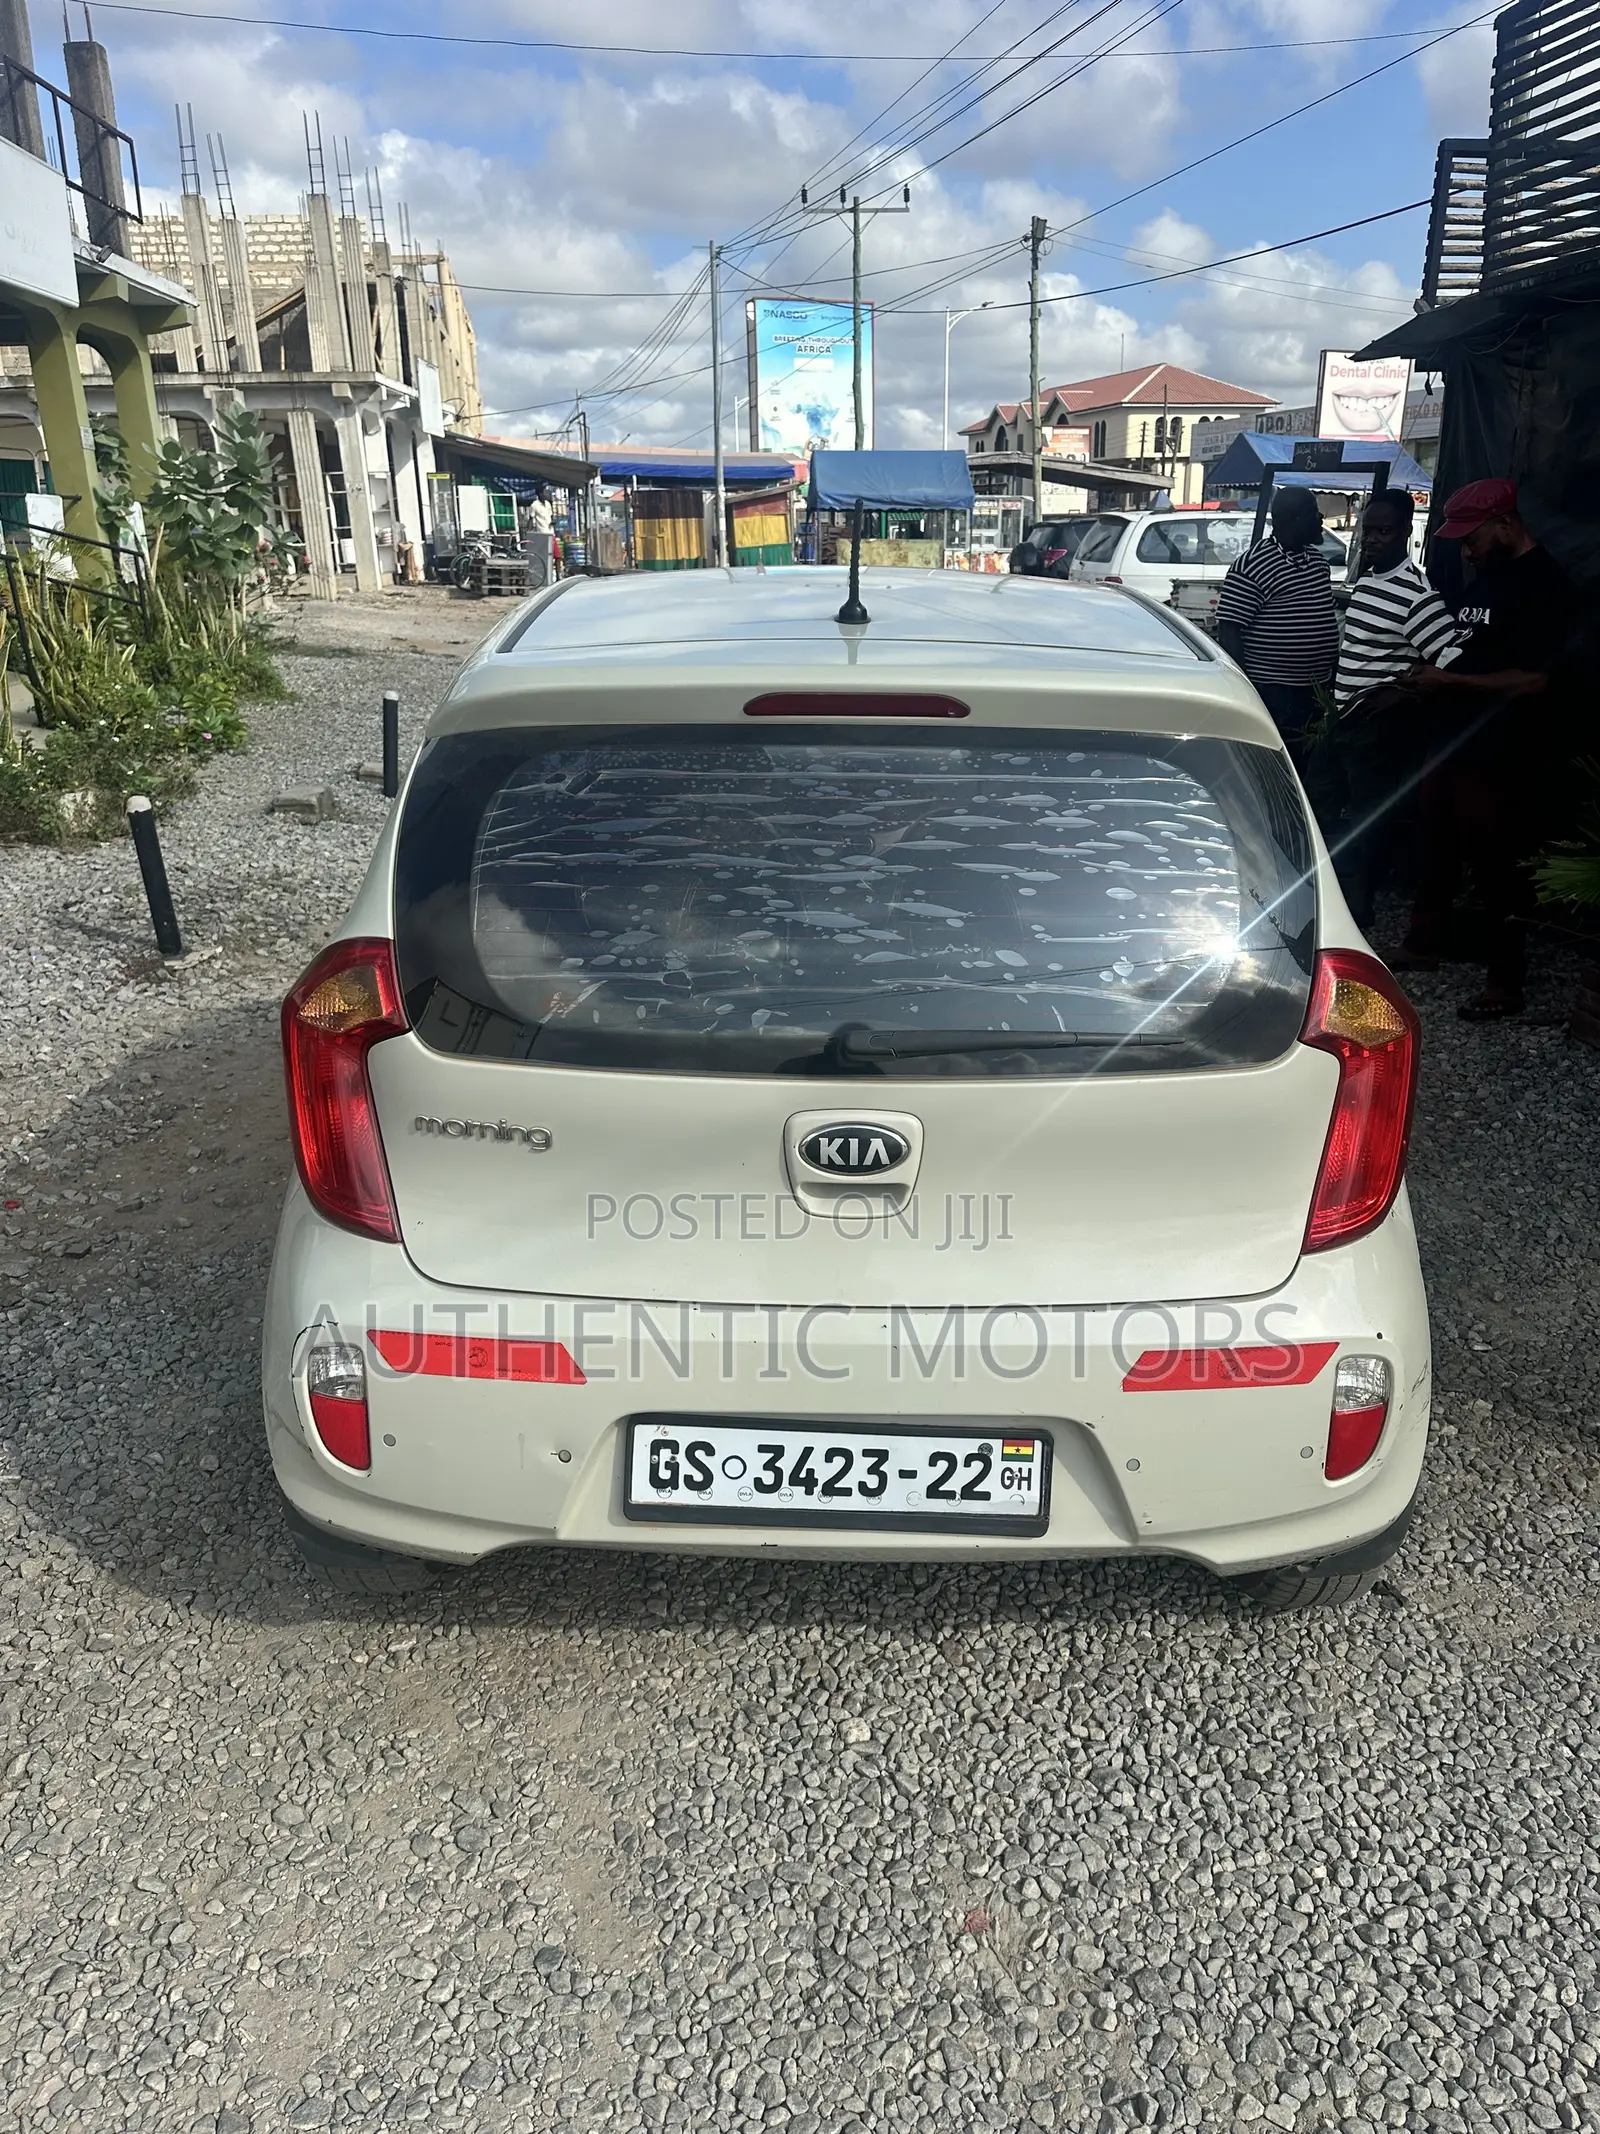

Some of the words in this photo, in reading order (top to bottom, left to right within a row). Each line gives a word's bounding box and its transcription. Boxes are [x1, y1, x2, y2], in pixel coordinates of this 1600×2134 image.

[797, 345, 832, 353] AFRICA
[1330, 365, 1371, 379] Dental
[1374, 365, 1407, 379] Clinic
[415, 1114, 553, 1151] morning
[818, 1137, 891, 1166] KIA
[649, 1438, 716, 1491] GS
[1000, 1466, 1033, 1491] GH
